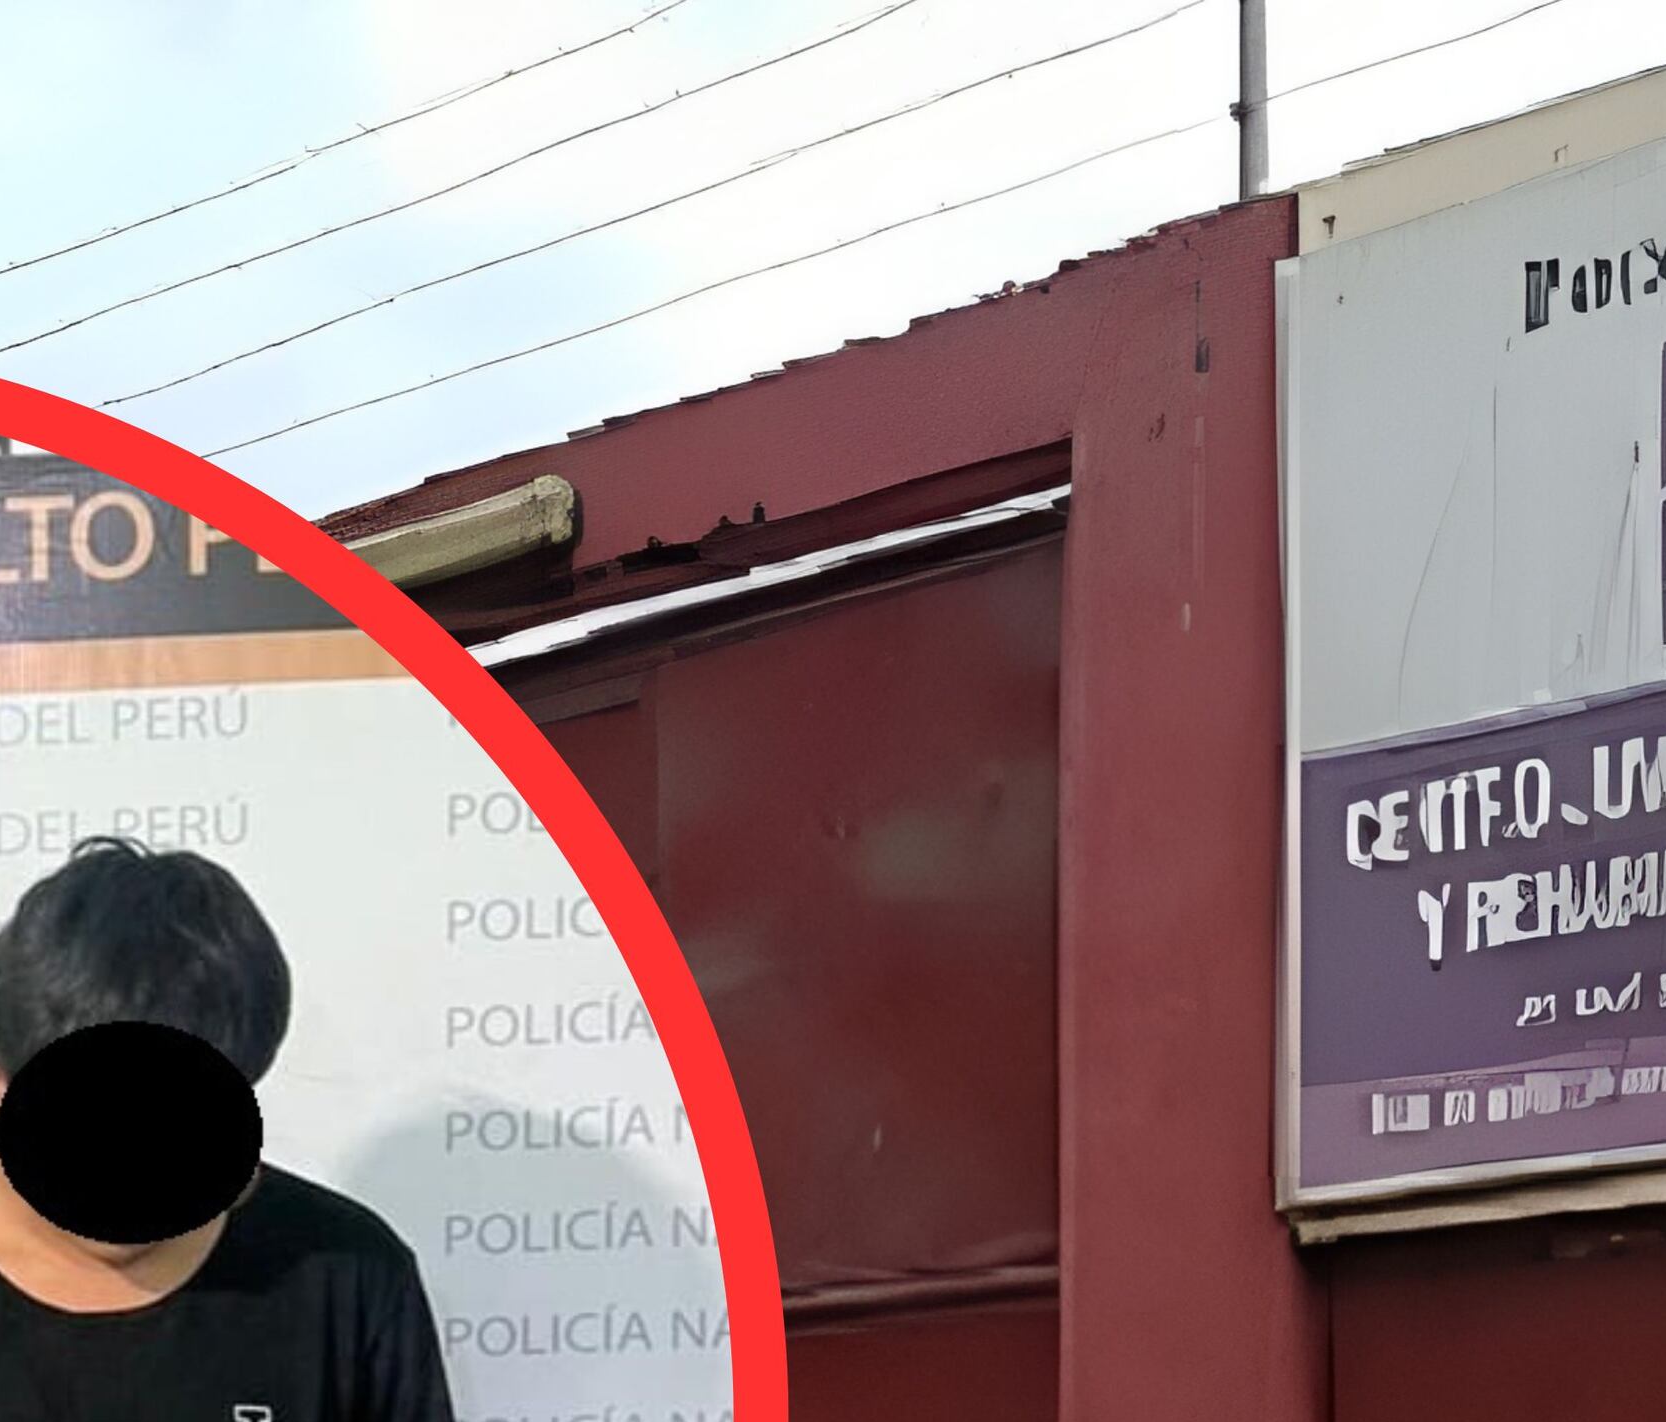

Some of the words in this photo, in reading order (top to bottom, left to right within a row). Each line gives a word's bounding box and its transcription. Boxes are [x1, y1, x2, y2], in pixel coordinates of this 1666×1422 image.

[112, 687, 248, 741] PERÚ
[113, 797, 248, 852] PERÚ
[447, 991, 659, 1049] POLICÍA
[445, 1097, 655, 1153] POLICÍA
[444, 1201, 653, 1256] POLICÍA
[444, 1303, 652, 1358] POLICÍA
